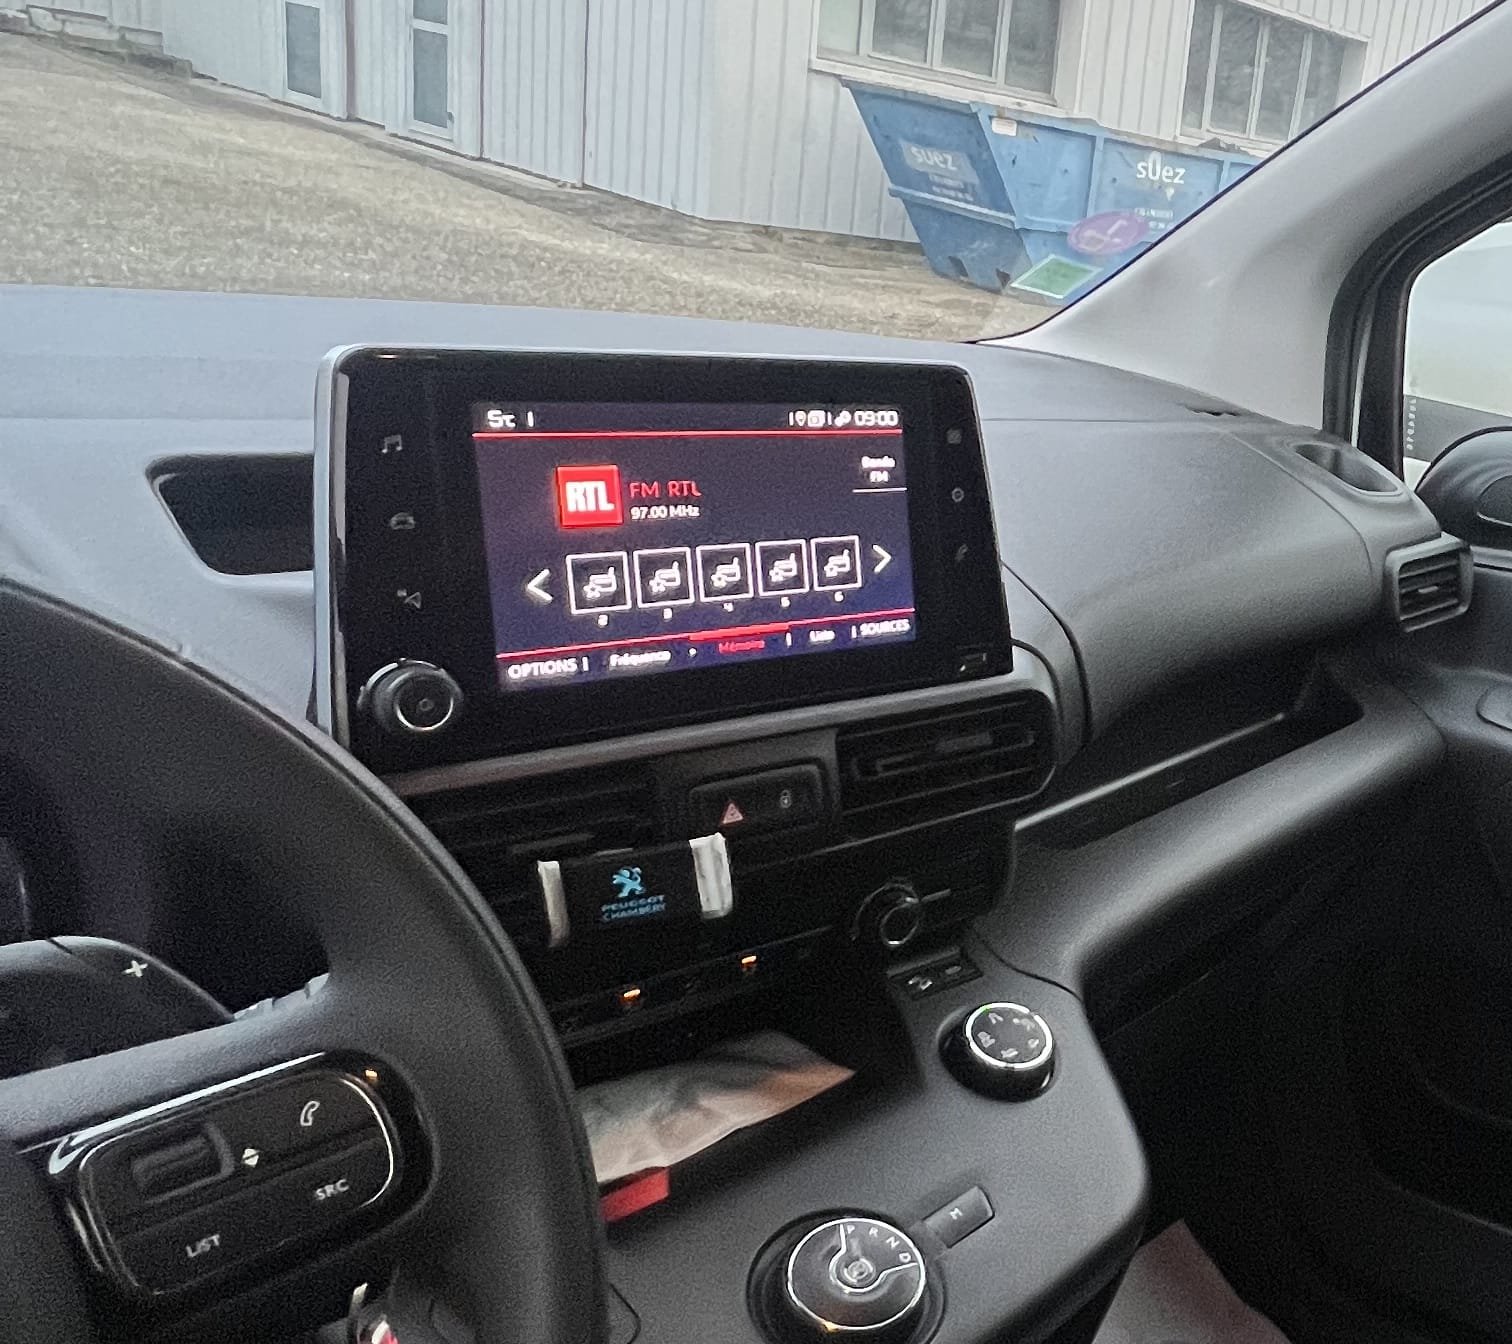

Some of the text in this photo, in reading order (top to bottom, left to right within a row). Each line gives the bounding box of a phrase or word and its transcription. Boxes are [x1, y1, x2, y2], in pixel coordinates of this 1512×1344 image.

[1136, 151, 1186, 184] suez
[854, 410, 899, 427] 09:00
[565, 480, 615, 513] RTL
[629, 480, 702, 499] FM RTL
[630, 503, 701, 520] 97.00 MHz
[859, 618, 911, 636] SOURCES
[507, 658, 578, 679] OPTIONS
[601, 895, 665, 912] PEUGEOT
[314, 1178, 350, 1201] SRC
[186, 1234, 220, 1258] LIST
[868, 1226, 879, 1238] R
[886, 1235, 900, 1249] N
[899, 1252, 912, 1263] D
